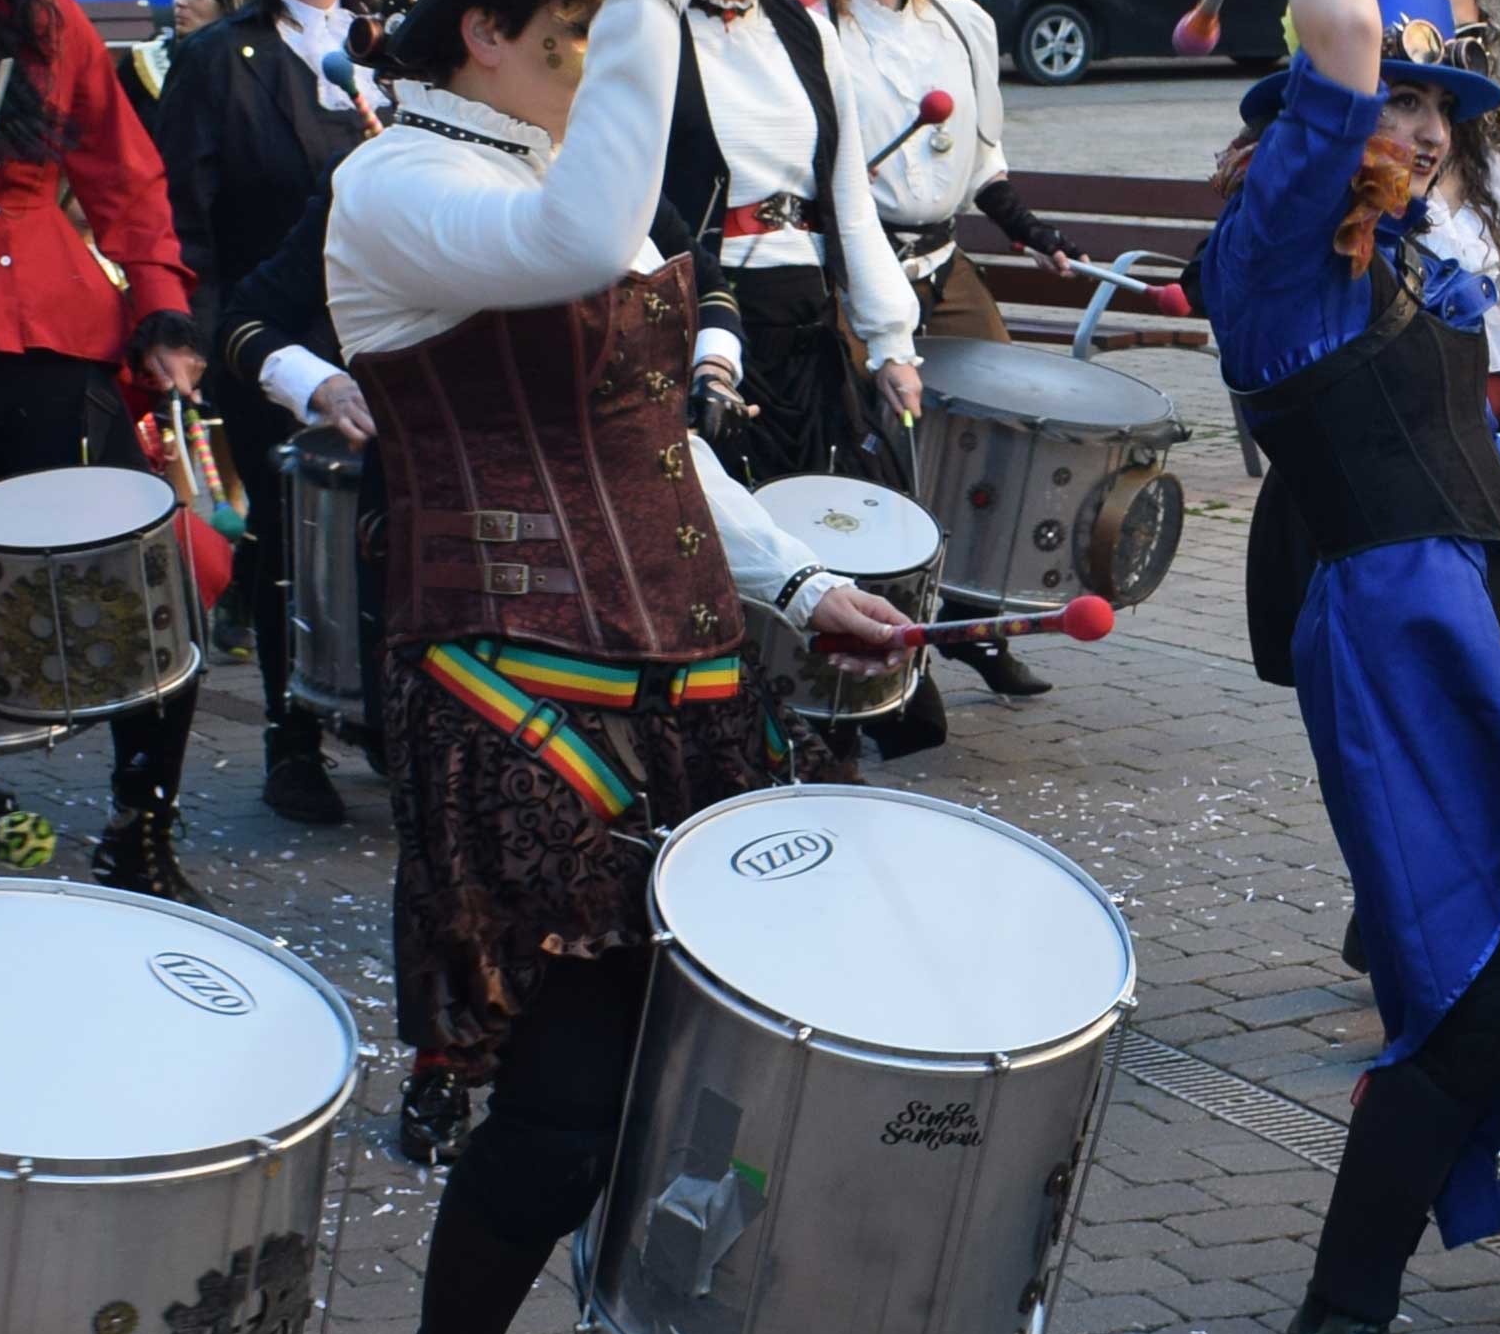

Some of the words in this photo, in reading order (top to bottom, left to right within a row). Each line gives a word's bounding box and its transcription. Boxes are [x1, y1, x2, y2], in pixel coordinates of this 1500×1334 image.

[741, 835, 820, 876] IZZO
[156, 959, 244, 1008] IZZO
[897, 1100, 979, 1128] Simba
